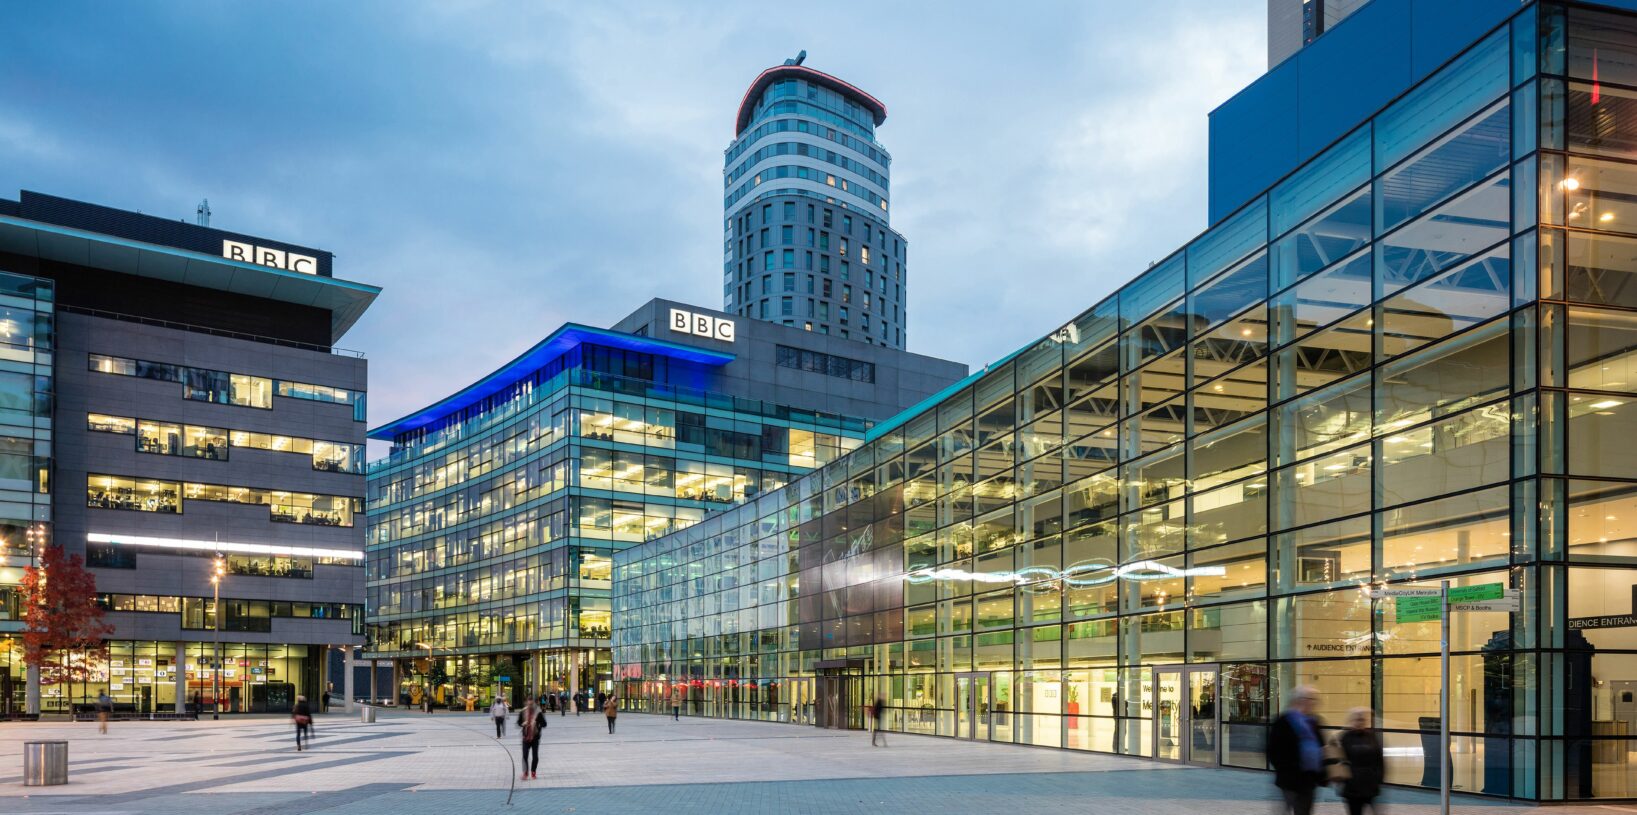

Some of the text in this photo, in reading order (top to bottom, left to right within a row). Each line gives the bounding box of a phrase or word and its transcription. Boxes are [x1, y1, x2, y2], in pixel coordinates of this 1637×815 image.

[229, 243, 313, 273] BBC
[673, 310, 732, 339] BBC
[1601, 616, 1637, 626] ENTRAN
[1313, 644, 1344, 652] AUDIENCE
[1143, 685, 1175, 693] Weme to
